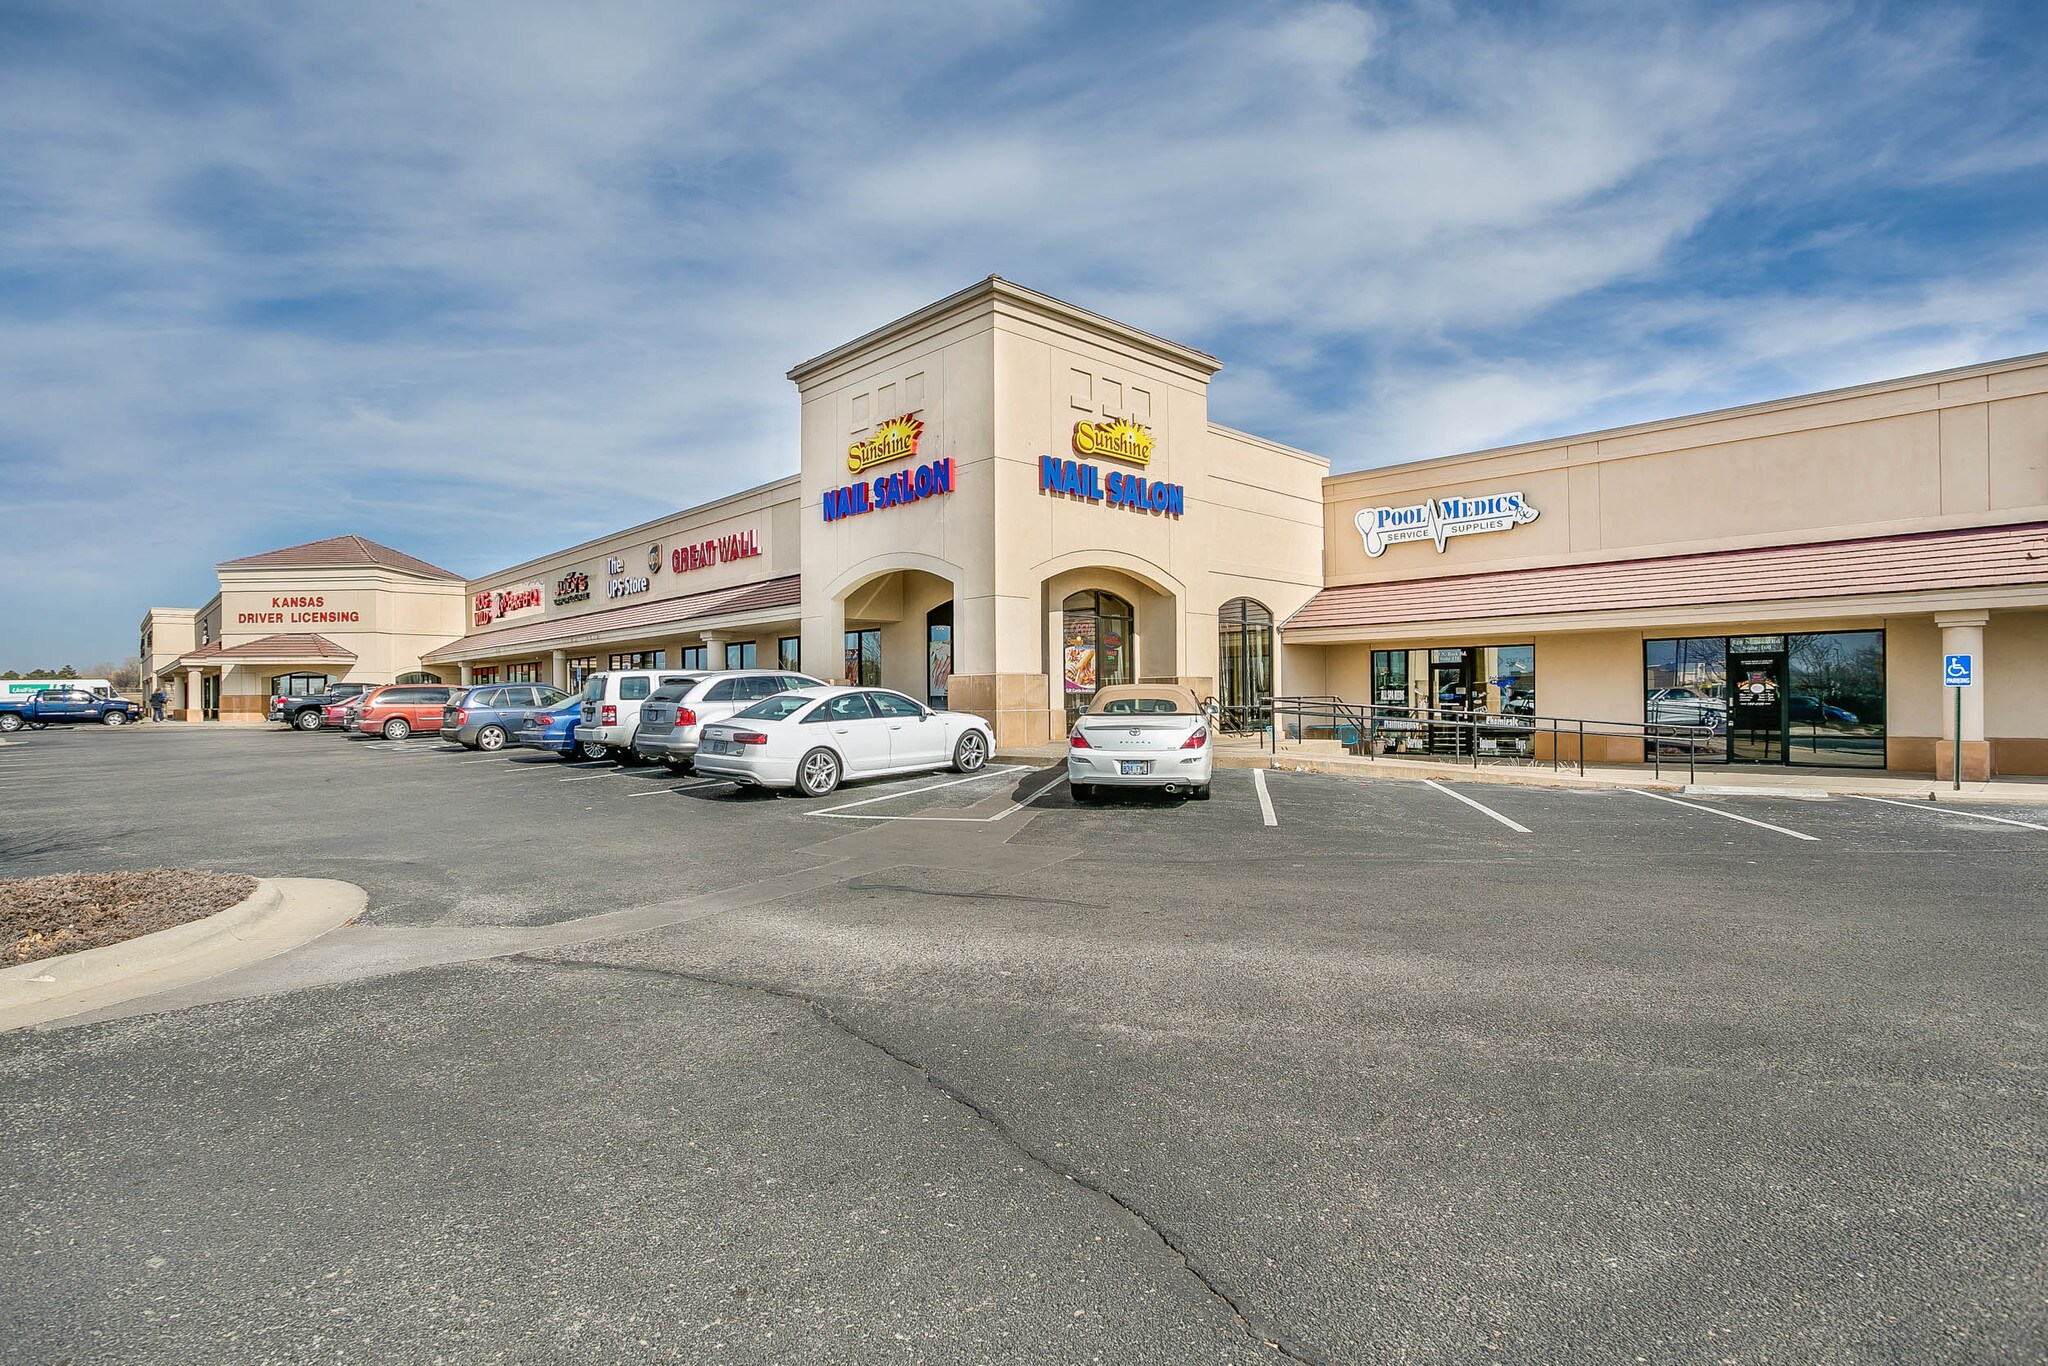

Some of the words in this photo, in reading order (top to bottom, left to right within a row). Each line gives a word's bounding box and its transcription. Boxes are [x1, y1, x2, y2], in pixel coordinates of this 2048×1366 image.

[848, 433, 912, 471] Sunshine
[1076, 421, 1149, 459] Sunshine
[823, 482, 872, 521] NAIL
[873, 457, 954, 508] SALON
[1040, 455, 1104, 500] NAIL
[1105, 471, 1184, 515] SALON
[1377, 508, 1426, 528] POOL
[1442, 495, 1520, 520] MEDICS
[1387, 530, 1429, 541] SERVICE
[1451, 520, 1504, 533] SUPPLIES
[607, 557, 624, 575] The
[672, 540, 717, 573] GREAT
[718, 529, 763, 562] WALL
[272, 597, 324, 608] KANSAS
[606, 578, 624, 598] UPS
[624, 576, 649, 596] Store
[238, 612, 284, 624] DRIVER
[291, 611, 359, 623] LICENSING
